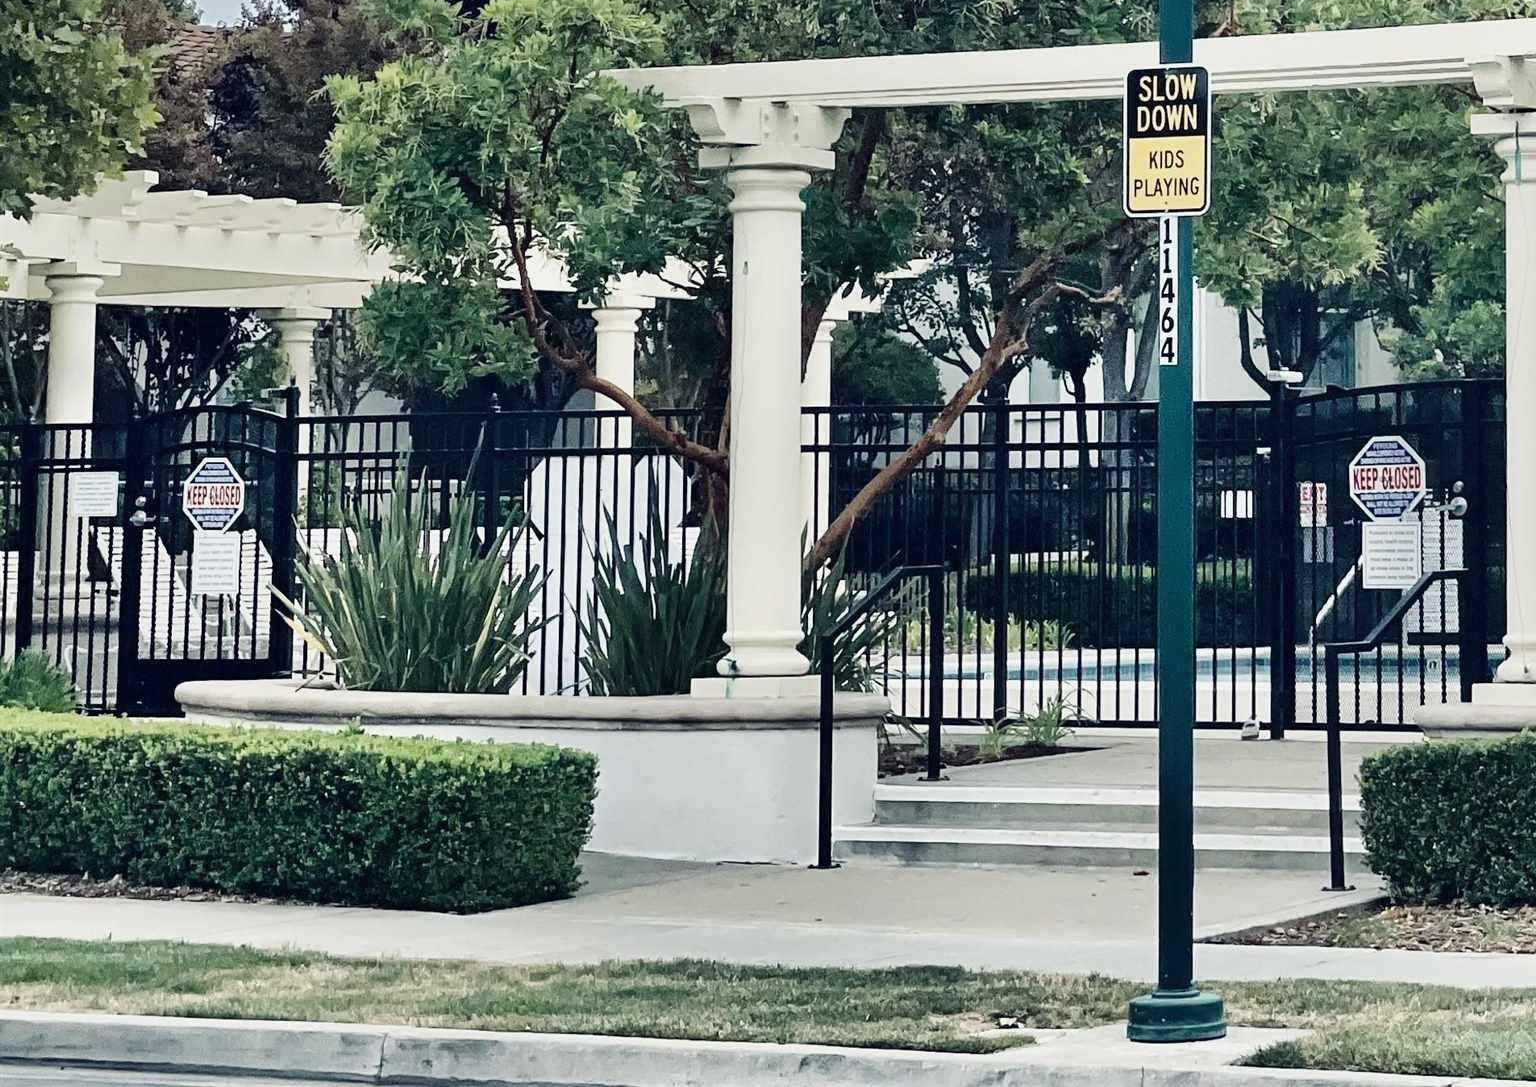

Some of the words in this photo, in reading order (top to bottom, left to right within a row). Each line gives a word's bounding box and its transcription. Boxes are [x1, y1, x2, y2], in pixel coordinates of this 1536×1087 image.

[1138, 73, 1197, 102] SLOW
[1136, 103, 1198, 132] DOWN
[1149, 150, 1185, 169] KIDS
[1133, 176, 1200, 198] PLAYING
[1160, 218, 1175, 363] 11464
[1353, 467, 1379, 491] KEEP
[1382, 465, 1421, 490] CLOSED
[187, 485, 208, 505] KEEP
[210, 485, 241, 506] CLOSED
